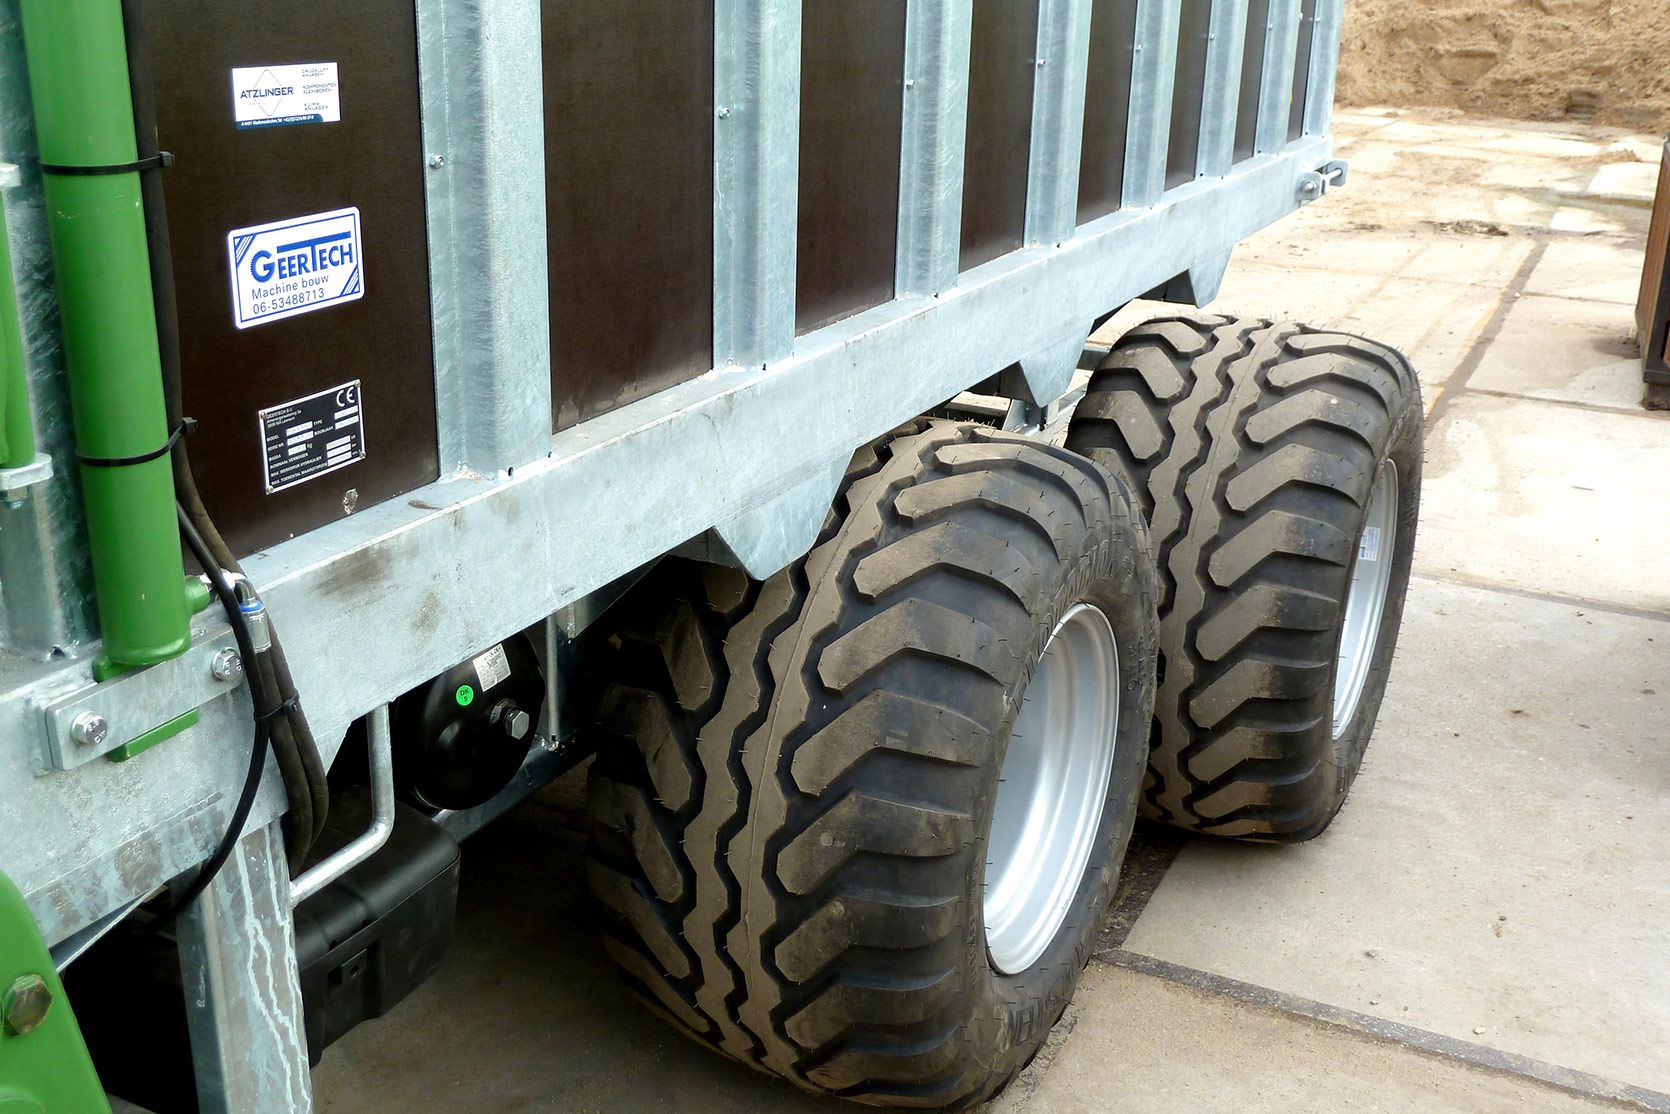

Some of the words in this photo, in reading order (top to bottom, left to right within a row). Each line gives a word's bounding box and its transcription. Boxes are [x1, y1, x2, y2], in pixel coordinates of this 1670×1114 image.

[240, 86, 293, 98] ATZLINGER
[252, 281, 298, 300] Machine
[301, 275, 329, 288] bouw
[253, 288, 325, 314] 06-53488713
